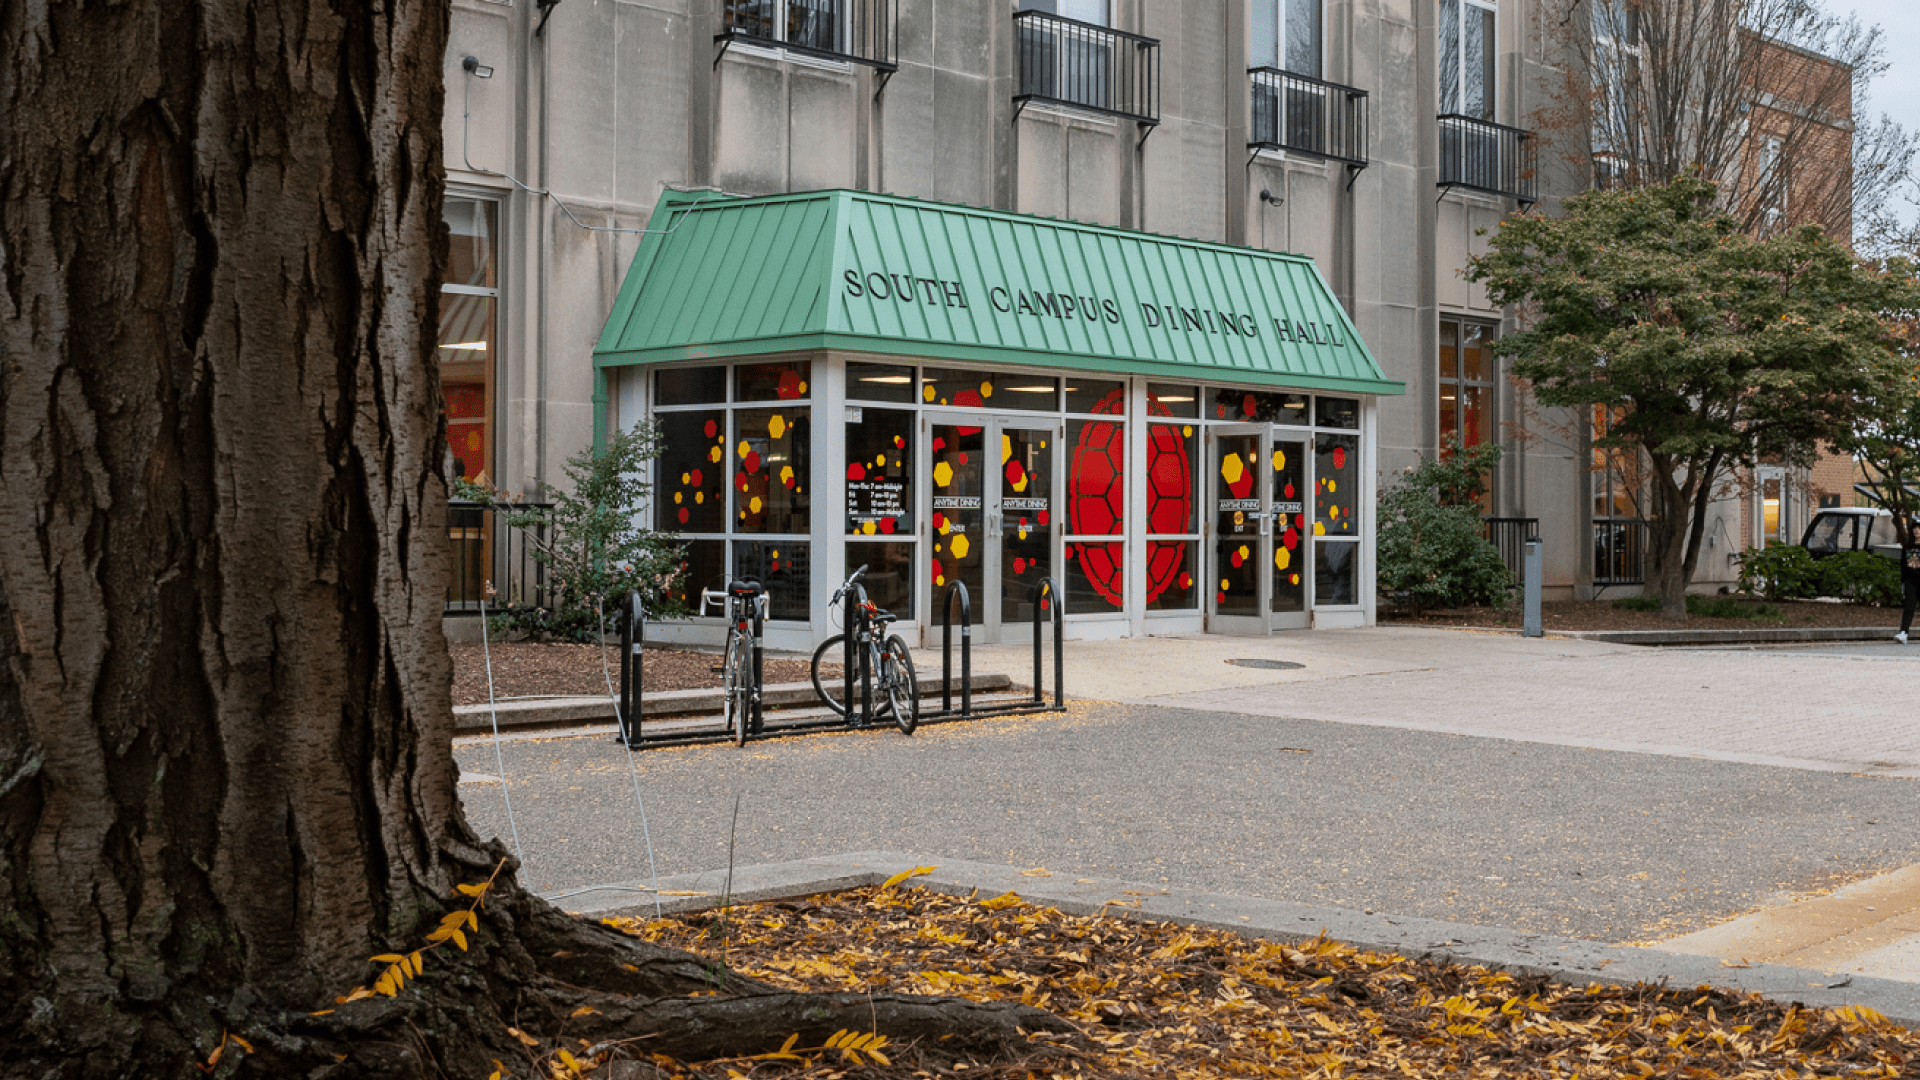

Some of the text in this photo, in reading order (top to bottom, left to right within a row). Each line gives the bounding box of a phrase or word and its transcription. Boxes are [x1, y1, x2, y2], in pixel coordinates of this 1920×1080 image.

[843, 268, 1345, 348] SOUTH CAMPUS DINING HALL
[934, 497, 982, 508] ANYTIME DINING
[1003, 499, 1048, 509] ANYTIME DINING
[1220, 501, 1260, 509] ANYTIME DINING
